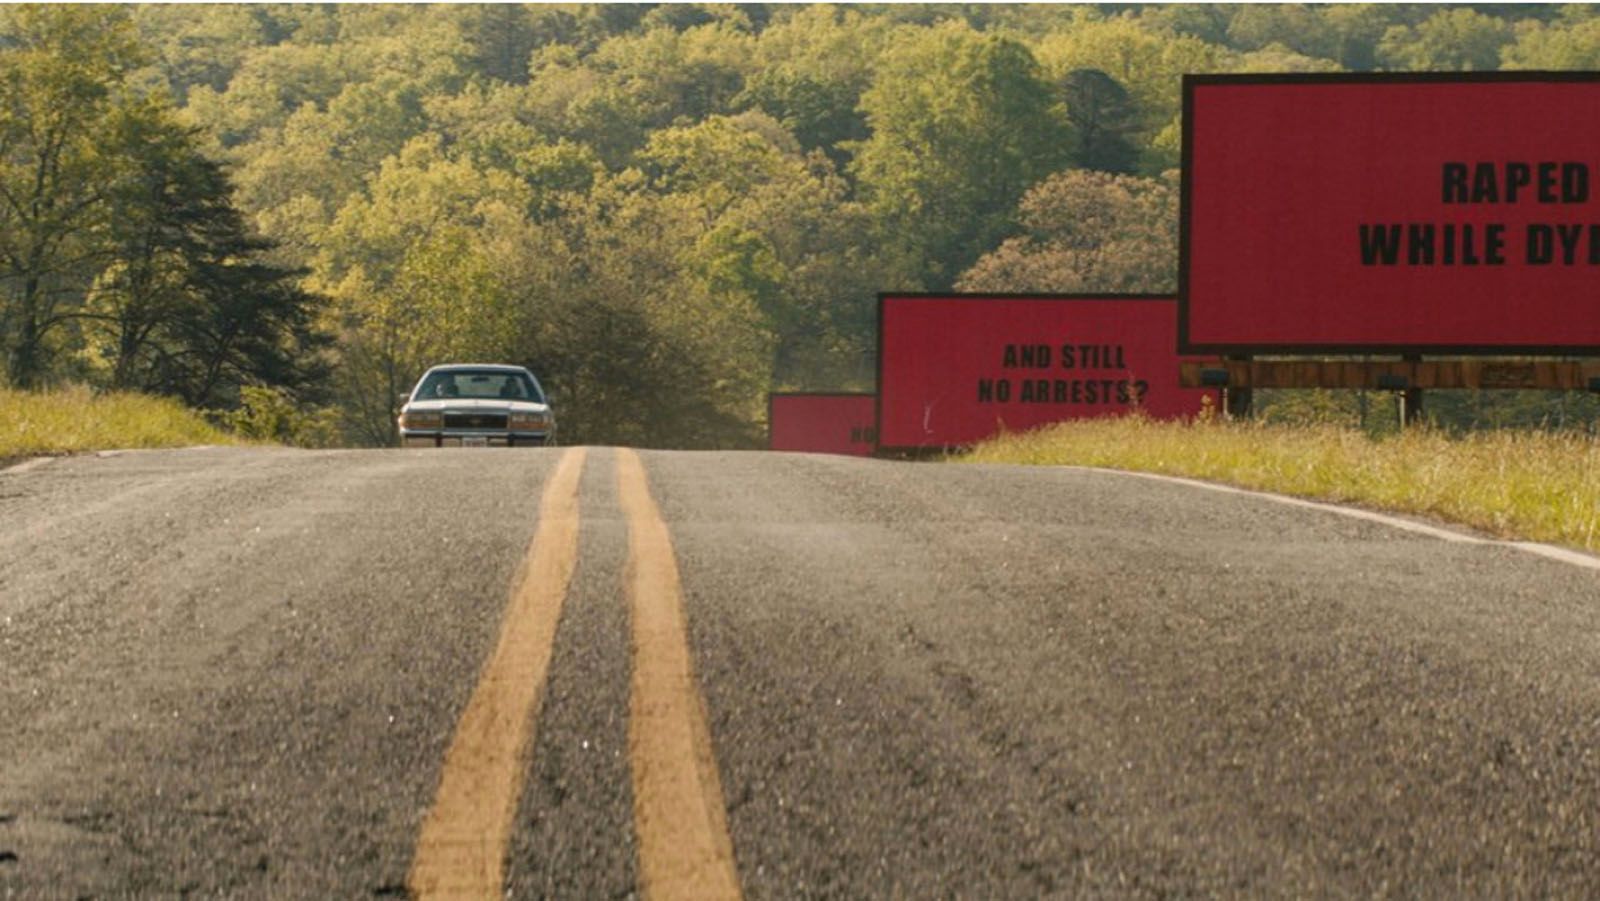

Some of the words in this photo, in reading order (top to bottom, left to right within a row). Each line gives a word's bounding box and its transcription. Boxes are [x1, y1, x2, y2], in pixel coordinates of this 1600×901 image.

[1441, 162, 1590, 204] RAPED
[1359, 223, 1506, 266] WHILE
[1003, 344, 1052, 369] AND
[1062, 344, 1127, 369] STILL
[978, 379, 1011, 402] NO
[1020, 379, 1149, 405] ARRESTS?
